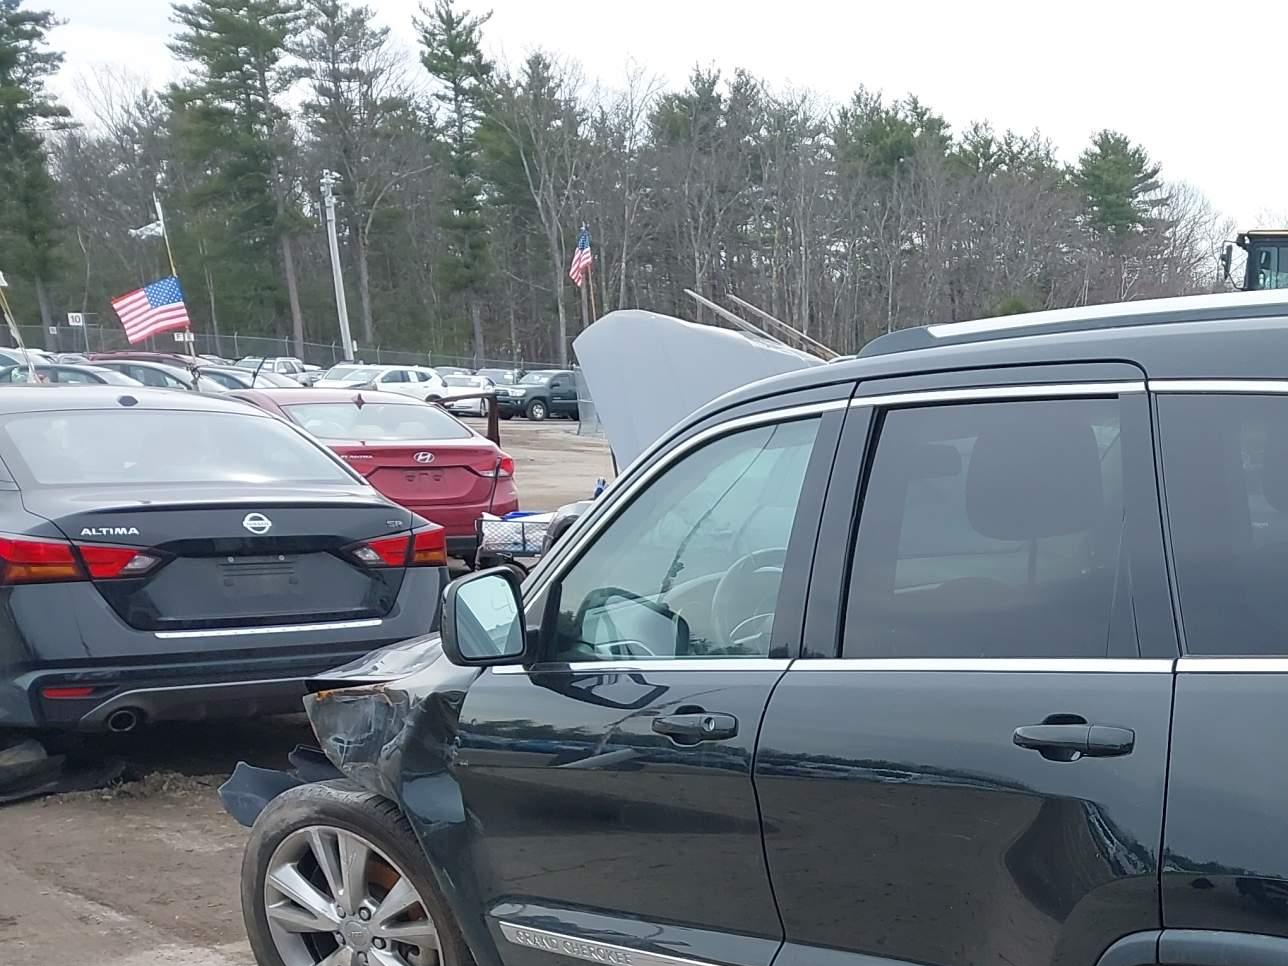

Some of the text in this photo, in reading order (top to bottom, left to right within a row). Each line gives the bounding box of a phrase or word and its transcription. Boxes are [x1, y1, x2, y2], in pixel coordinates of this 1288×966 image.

[70, 315, 81, 324] 10
[80, 527, 140, 536] ALTIMA
[516, 931, 633, 966] GRAND CHEROKEE
